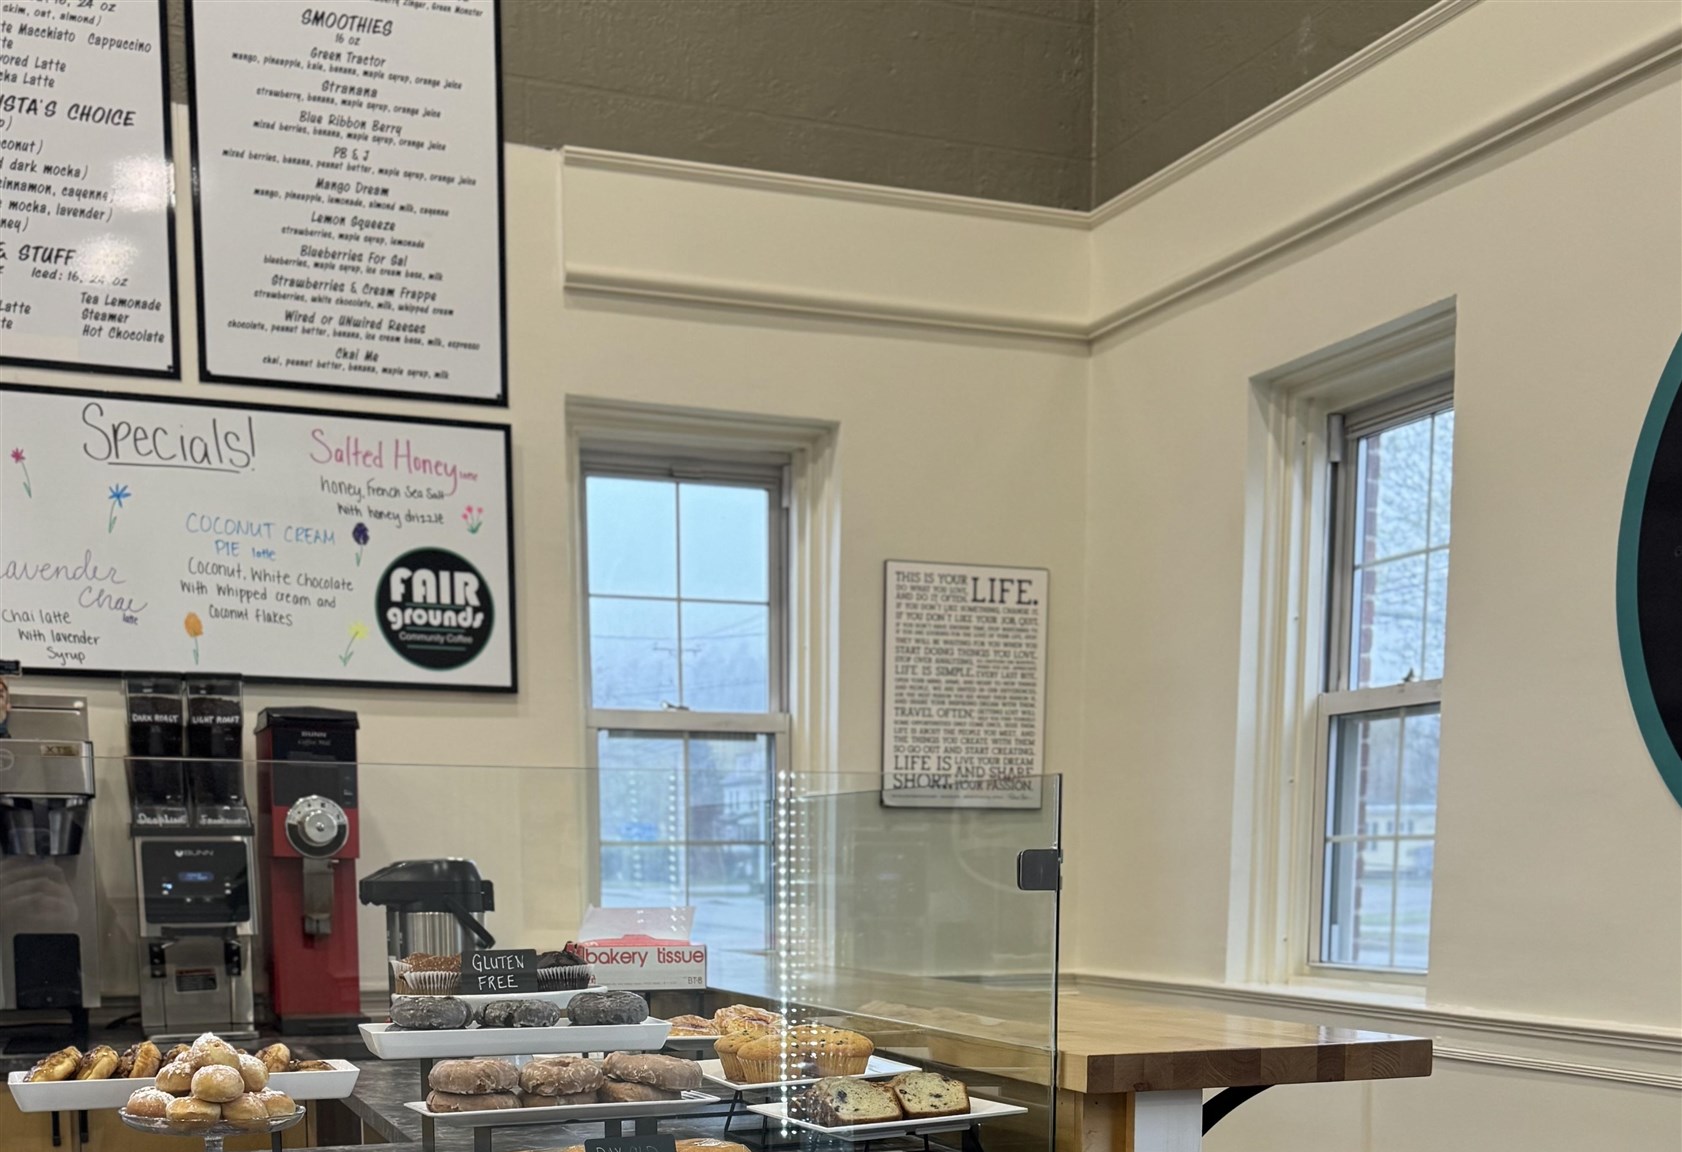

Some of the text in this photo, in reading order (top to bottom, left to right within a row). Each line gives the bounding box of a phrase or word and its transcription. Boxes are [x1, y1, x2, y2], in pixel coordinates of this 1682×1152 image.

[301, 9, 393, 36] SMOOTHIES
[18, 23, 152, 52] Macchiato Cappuccino
[335, 33, 360, 46] 16 oz
[35, 56, 66, 72] Latte
[310, 47, 386, 67] Green Tractor
[23, 73, 55, 87] Latte
[322, 80, 377, 98] Stranana
[68, 103, 136, 126] CHOICE
[299, 111, 402, 136] Blue Ribbon Berry
[333, 146, 347, 159] PB
[10, 159, 88, 180] dark mocha)
[316, 177, 389, 197] Mango Dream
[56, 204, 113, 223] lavender)
[311, 211, 396, 232] Lemon Squeeze
[18, 245, 76, 265] STUFF
[300, 244, 407, 267] Blueberries For Sal
[32, 267, 63, 280] Iced:
[271, 274, 437, 302] Strawberries Cream Frappe
[81, 292, 161, 311] Tea Lemonade
[82, 308, 130, 323] Steamer
[284, 310, 426, 334] Wired or Reeses
[83, 325, 164, 344] Hot Chocolate
[335, 348, 379, 362] Chai Me
[82, 402, 256, 472] Specials!
[310, 428, 458, 496] Salted Honey
[405, 485, 423, 498] Sea
[368, 506, 401, 528] honey
[186, 513, 334, 544] COCONUT CREAM
[215, 539, 240, 557] PIE
[0, 550, 126, 584] avender
[251, 568, 290, 585] White
[390, 567, 480, 606] FAIR
[895, 571, 1038, 605] THIS IS YOUR LIFE.
[276, 591, 336, 609] cream and
[39, 609, 71, 624] latte
[256, 609, 293, 626] flakes
[387, 606, 484, 631] grounds
[51, 629, 99, 645] lavender
[399, 631, 473, 644] Community Coffee
[895, 665, 918, 675] LIFE
[132, 714, 152, 722] DARK
[894, 707, 934, 718] TRAVEL
[894, 755, 952, 771] LIFE IS
[954, 756, 974, 765] LIVE
[976, 757, 999, 765] YOUR
[954, 767, 985, 778] AND
[472, 954, 524, 972] GLUTEN
[586, 948, 704, 967] bakery tissue
[478, 975, 518, 990] FREE
